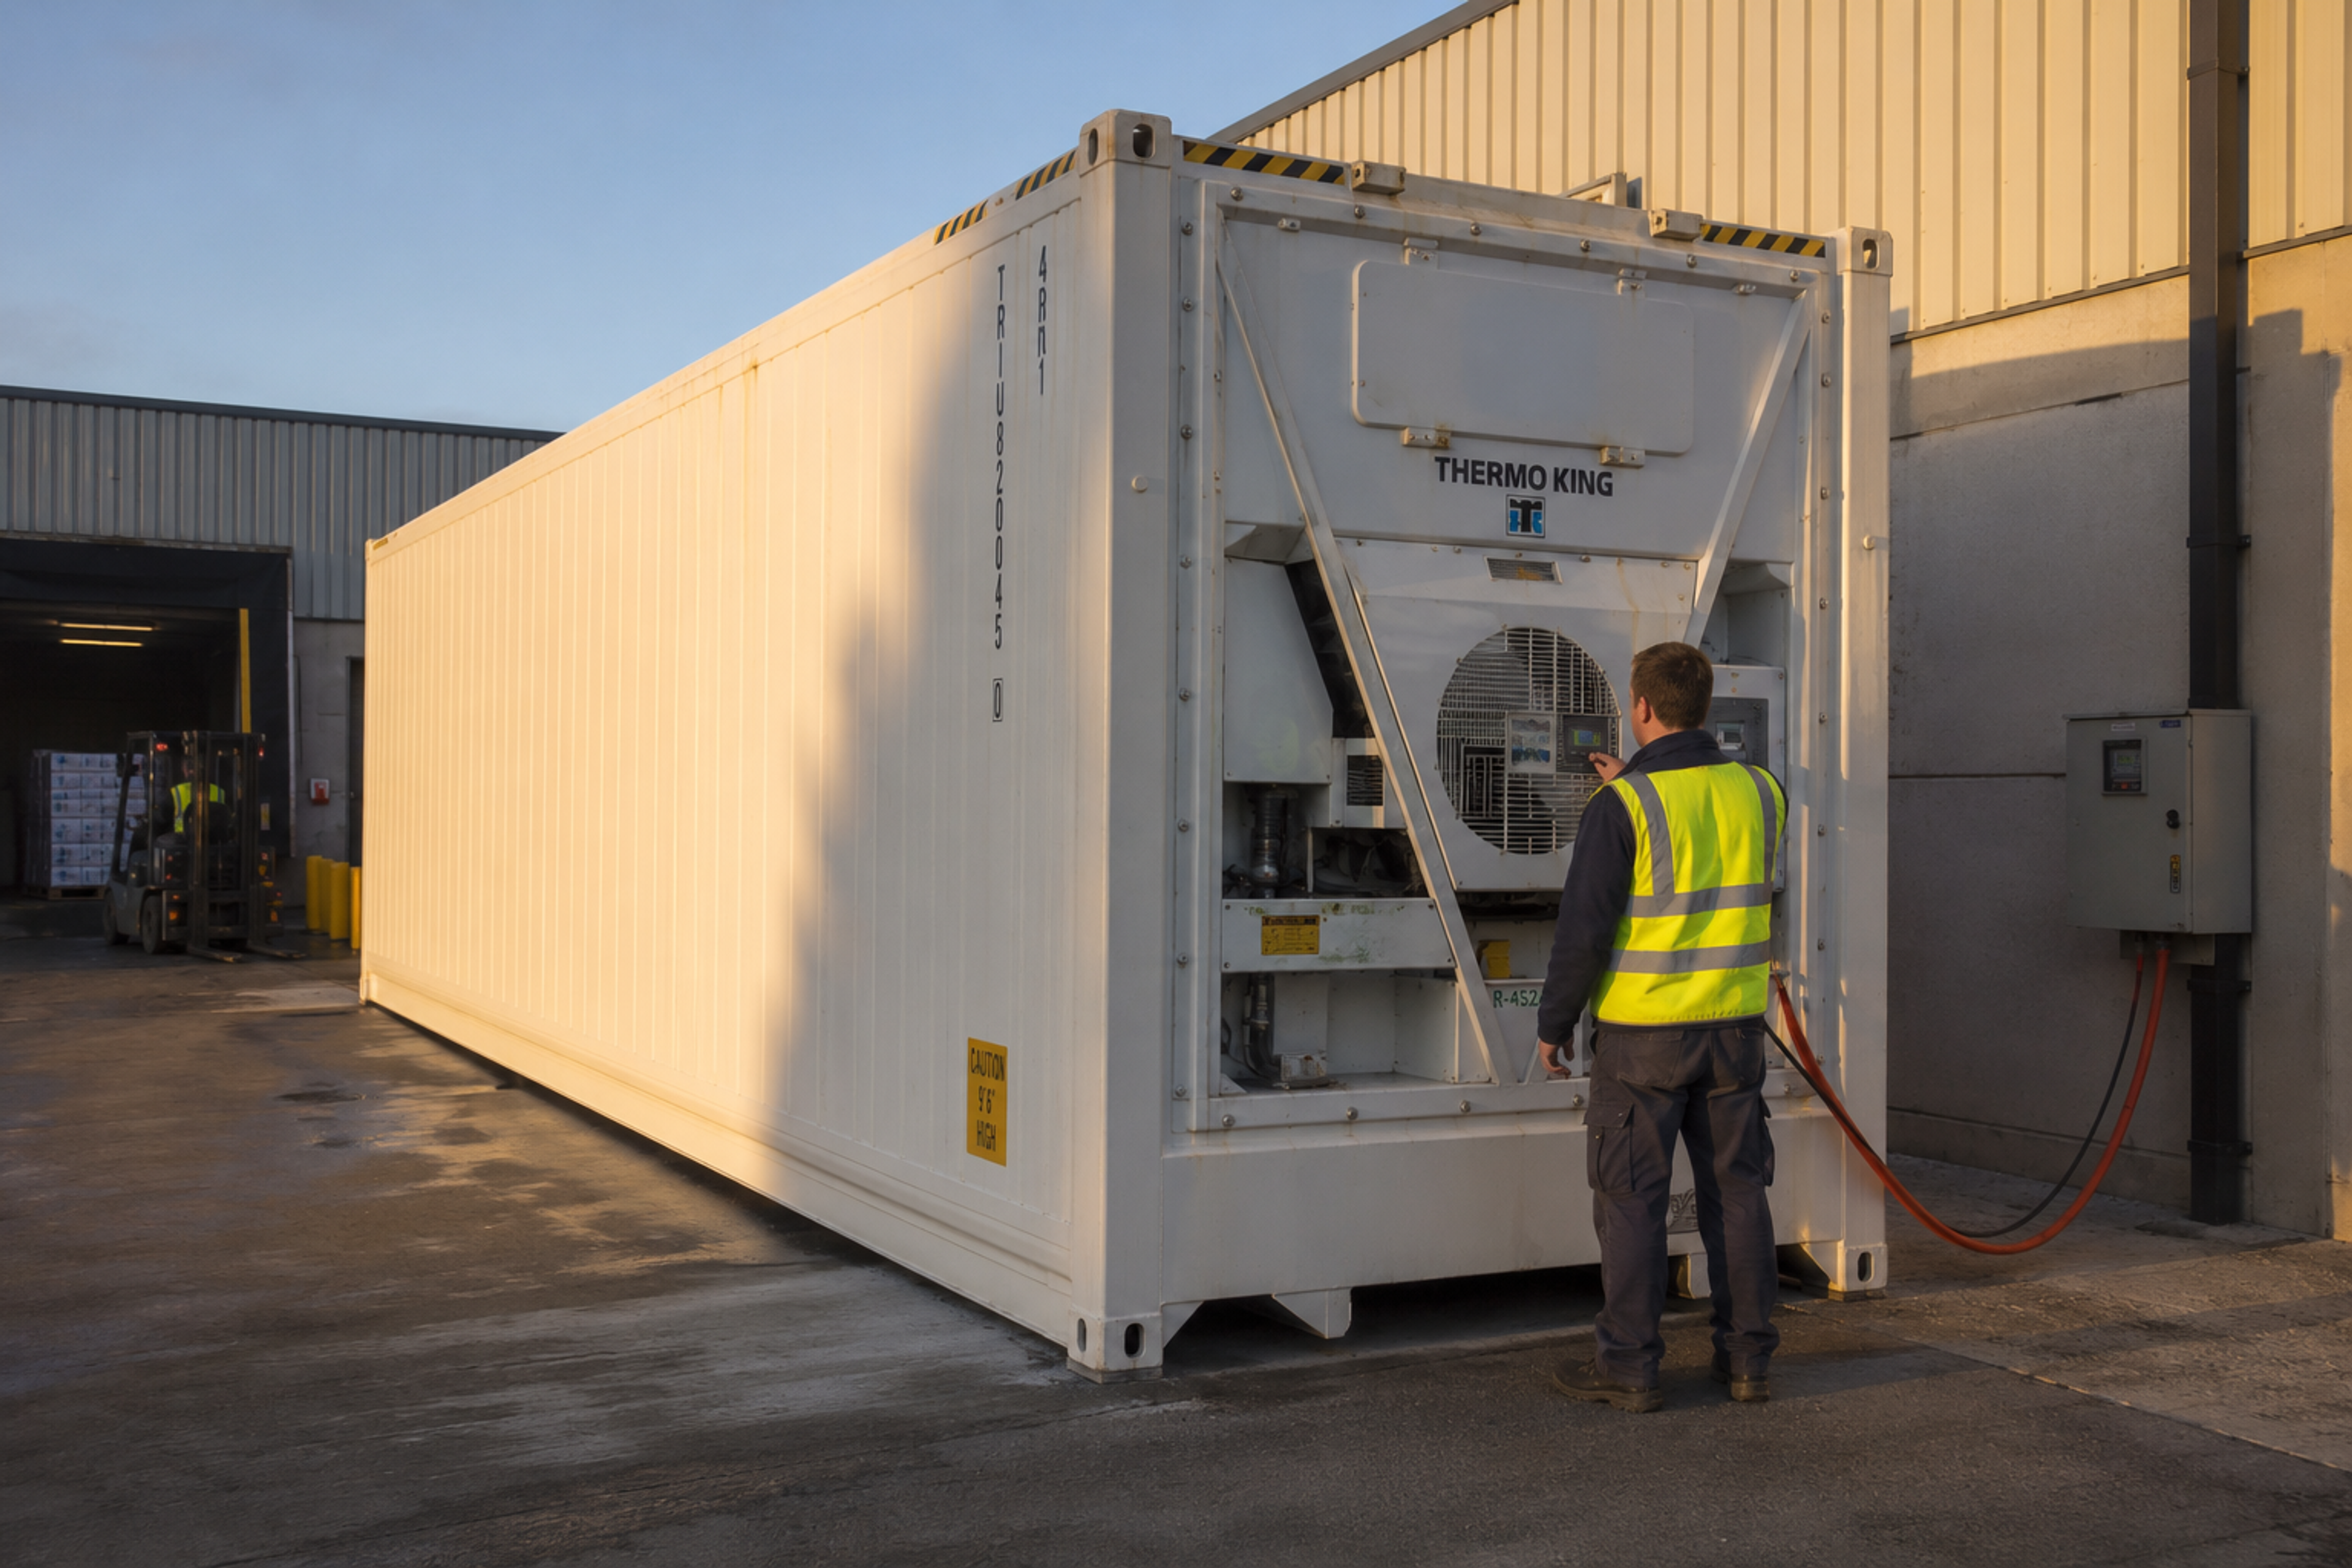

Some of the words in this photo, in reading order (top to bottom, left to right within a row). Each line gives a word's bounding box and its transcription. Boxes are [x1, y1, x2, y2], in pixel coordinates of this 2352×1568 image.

[1434, 456, 1547, 491] THERMO
[1553, 467, 1613, 497] KING
[993, 680, 1002, 720] 0
[970, 1047, 1005, 1082] CAUTION
[976, 1120, 997, 1152] HIGH
